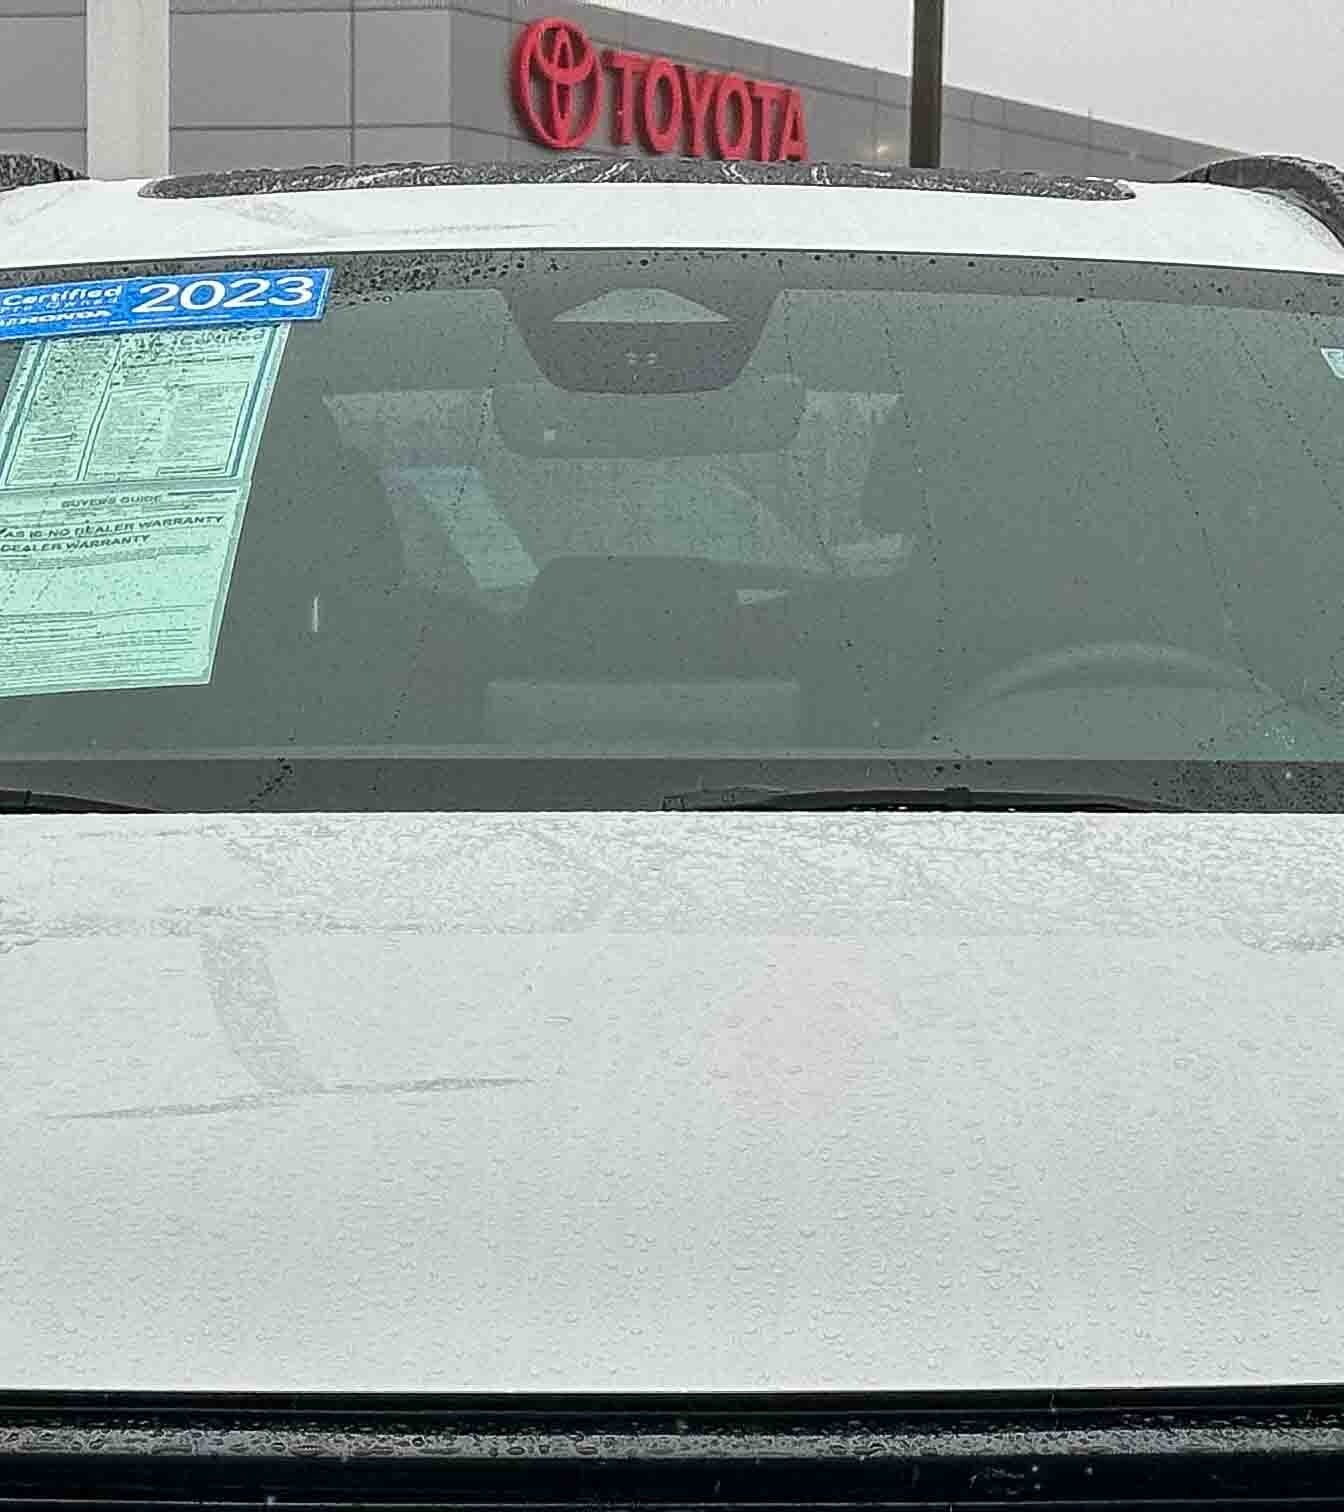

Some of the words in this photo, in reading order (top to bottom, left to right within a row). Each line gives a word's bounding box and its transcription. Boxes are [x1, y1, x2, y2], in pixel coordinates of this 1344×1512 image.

[602, 50, 809, 161] TOYOTA
[3, 285, 123, 305] Certified
[131, 276, 314, 313] 2023
[138, 515, 225, 530] WARRANTY
[65, 534, 152, 549] WARRANTY
